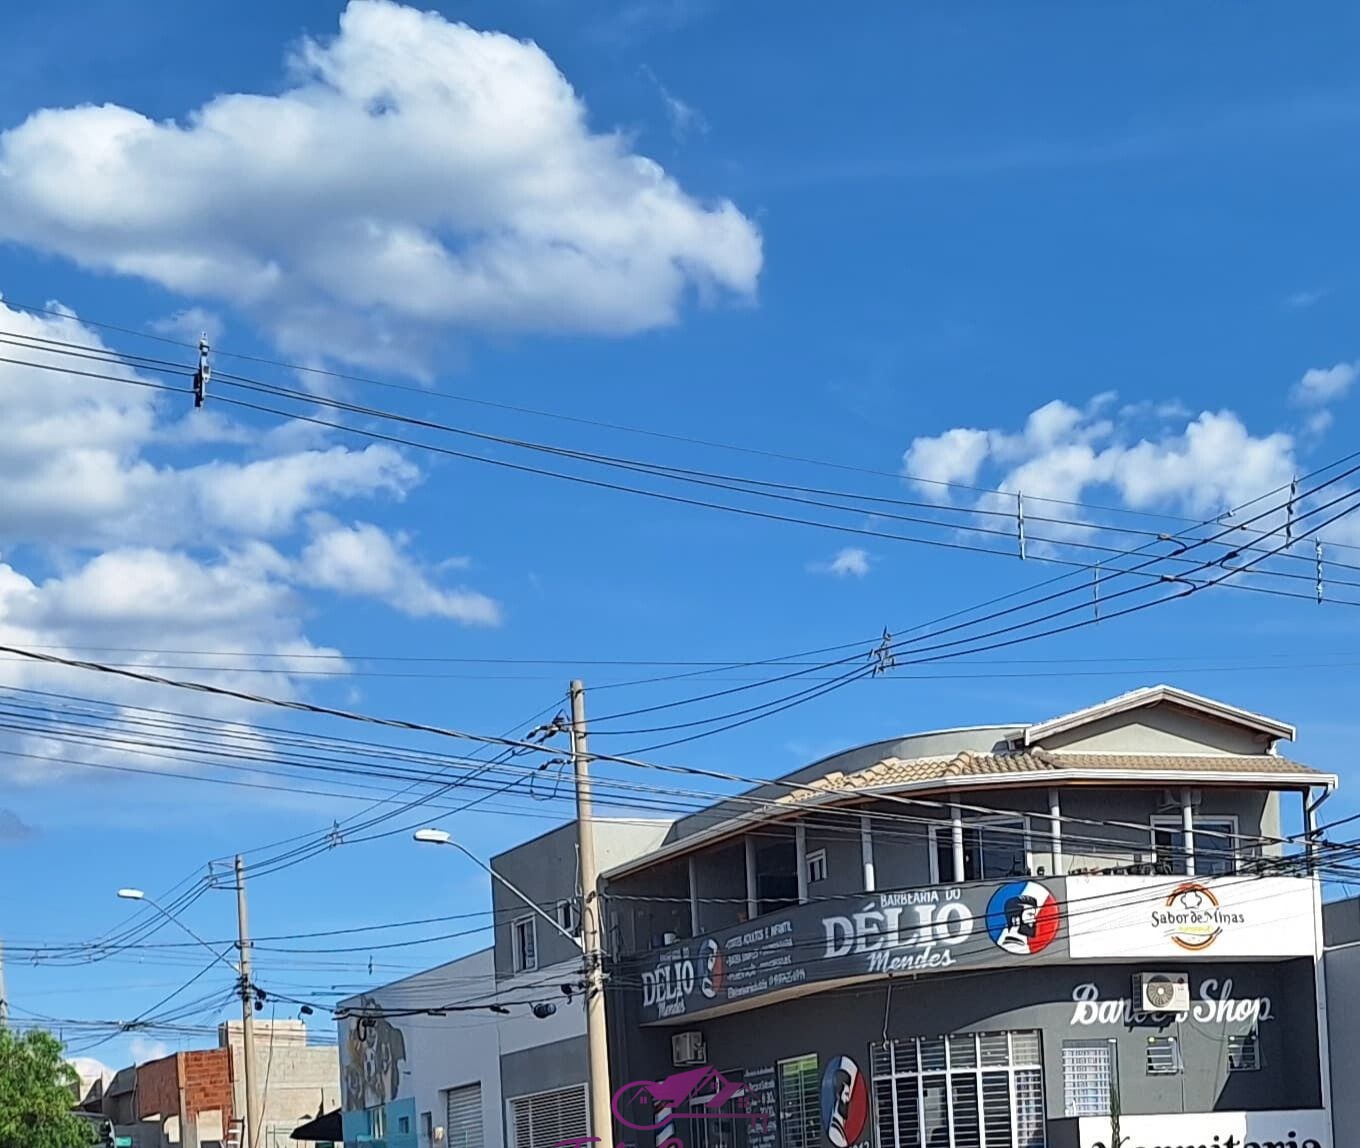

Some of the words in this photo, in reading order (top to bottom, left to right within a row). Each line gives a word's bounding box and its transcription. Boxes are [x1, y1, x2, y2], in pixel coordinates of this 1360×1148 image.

[880, 889, 939, 908] BARBEARIA
[945, 887, 961, 901] DO
[822, 902, 974, 958] DÉLIO
[1151, 911, 1189, 928] Sabor
[1190, 910, 1203, 924] de
[867, 945, 956, 972] Mendes
[641, 960, 694, 1009] DÉLIO
[1193, 979, 1274, 1031] Shop
